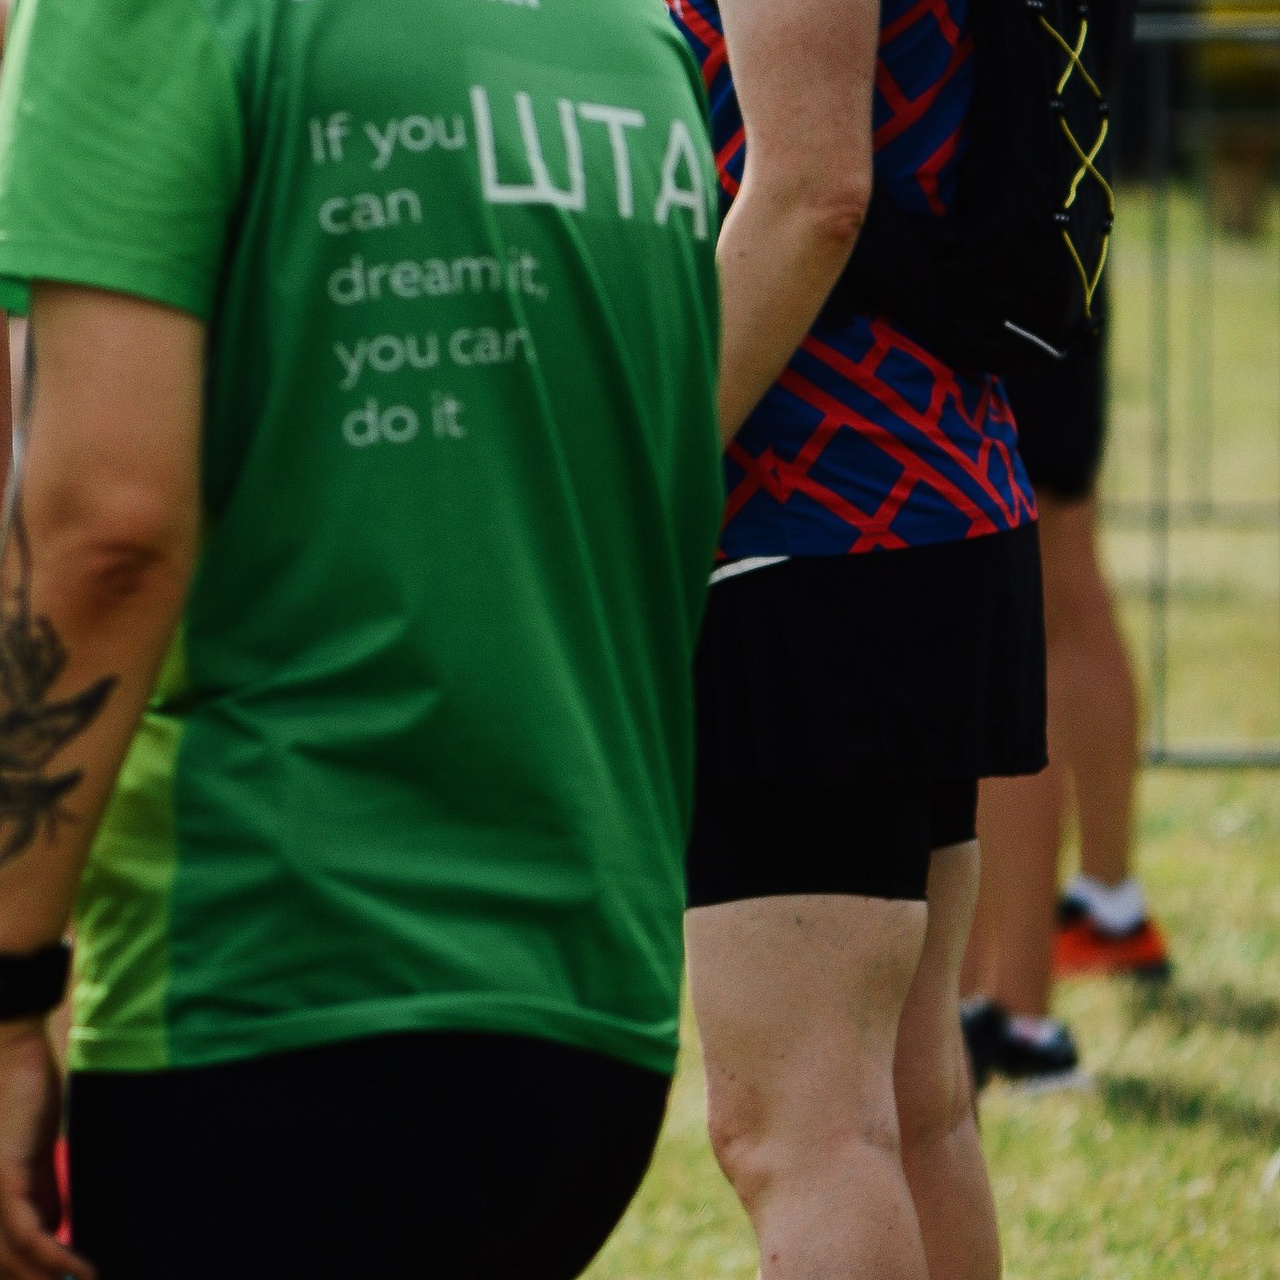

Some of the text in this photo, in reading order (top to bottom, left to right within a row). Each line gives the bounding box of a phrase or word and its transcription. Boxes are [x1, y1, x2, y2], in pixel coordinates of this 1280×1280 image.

[308, 111, 467, 170] If you
[318, 187, 421, 235] can
[334, 330, 440, 390] you
[341, 391, 466, 447] do it
